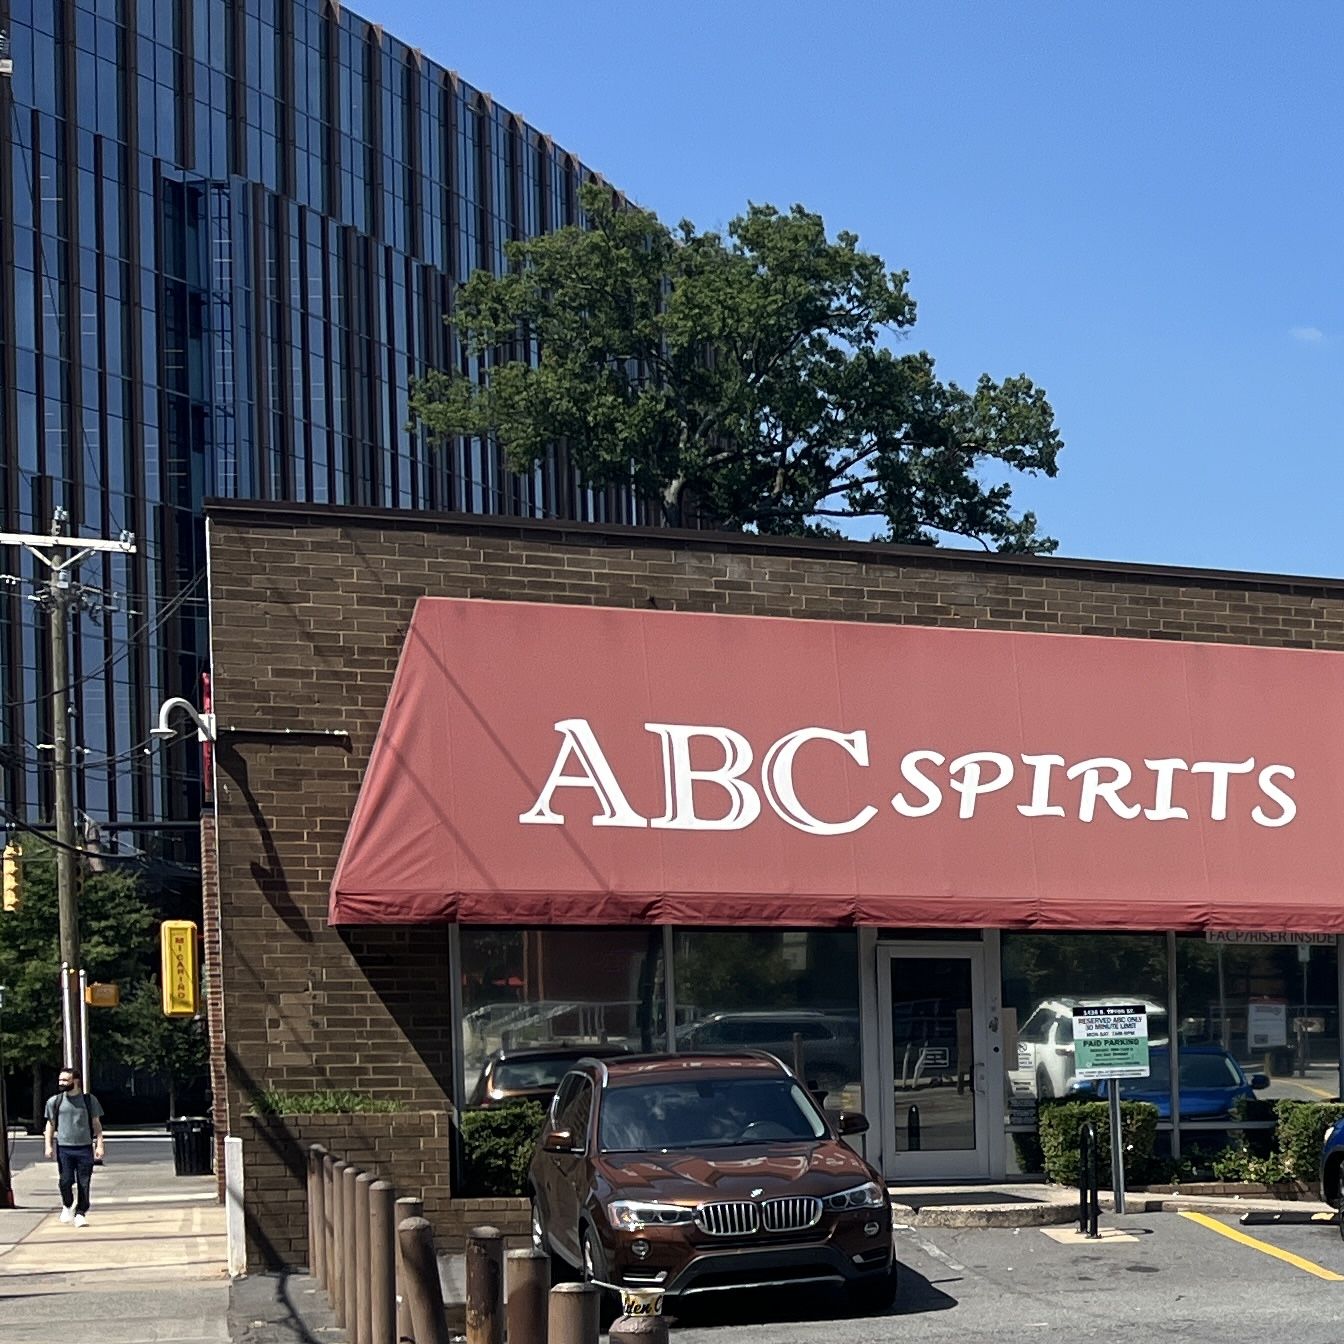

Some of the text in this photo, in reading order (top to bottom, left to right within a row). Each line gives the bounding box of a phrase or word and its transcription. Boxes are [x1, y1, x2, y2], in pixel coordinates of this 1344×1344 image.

[519, 718, 1297, 835] ABC SPIRITS
[1290, 931, 1335, 944] INSIDE
[1104, 1038, 1139, 1046] PARKING
